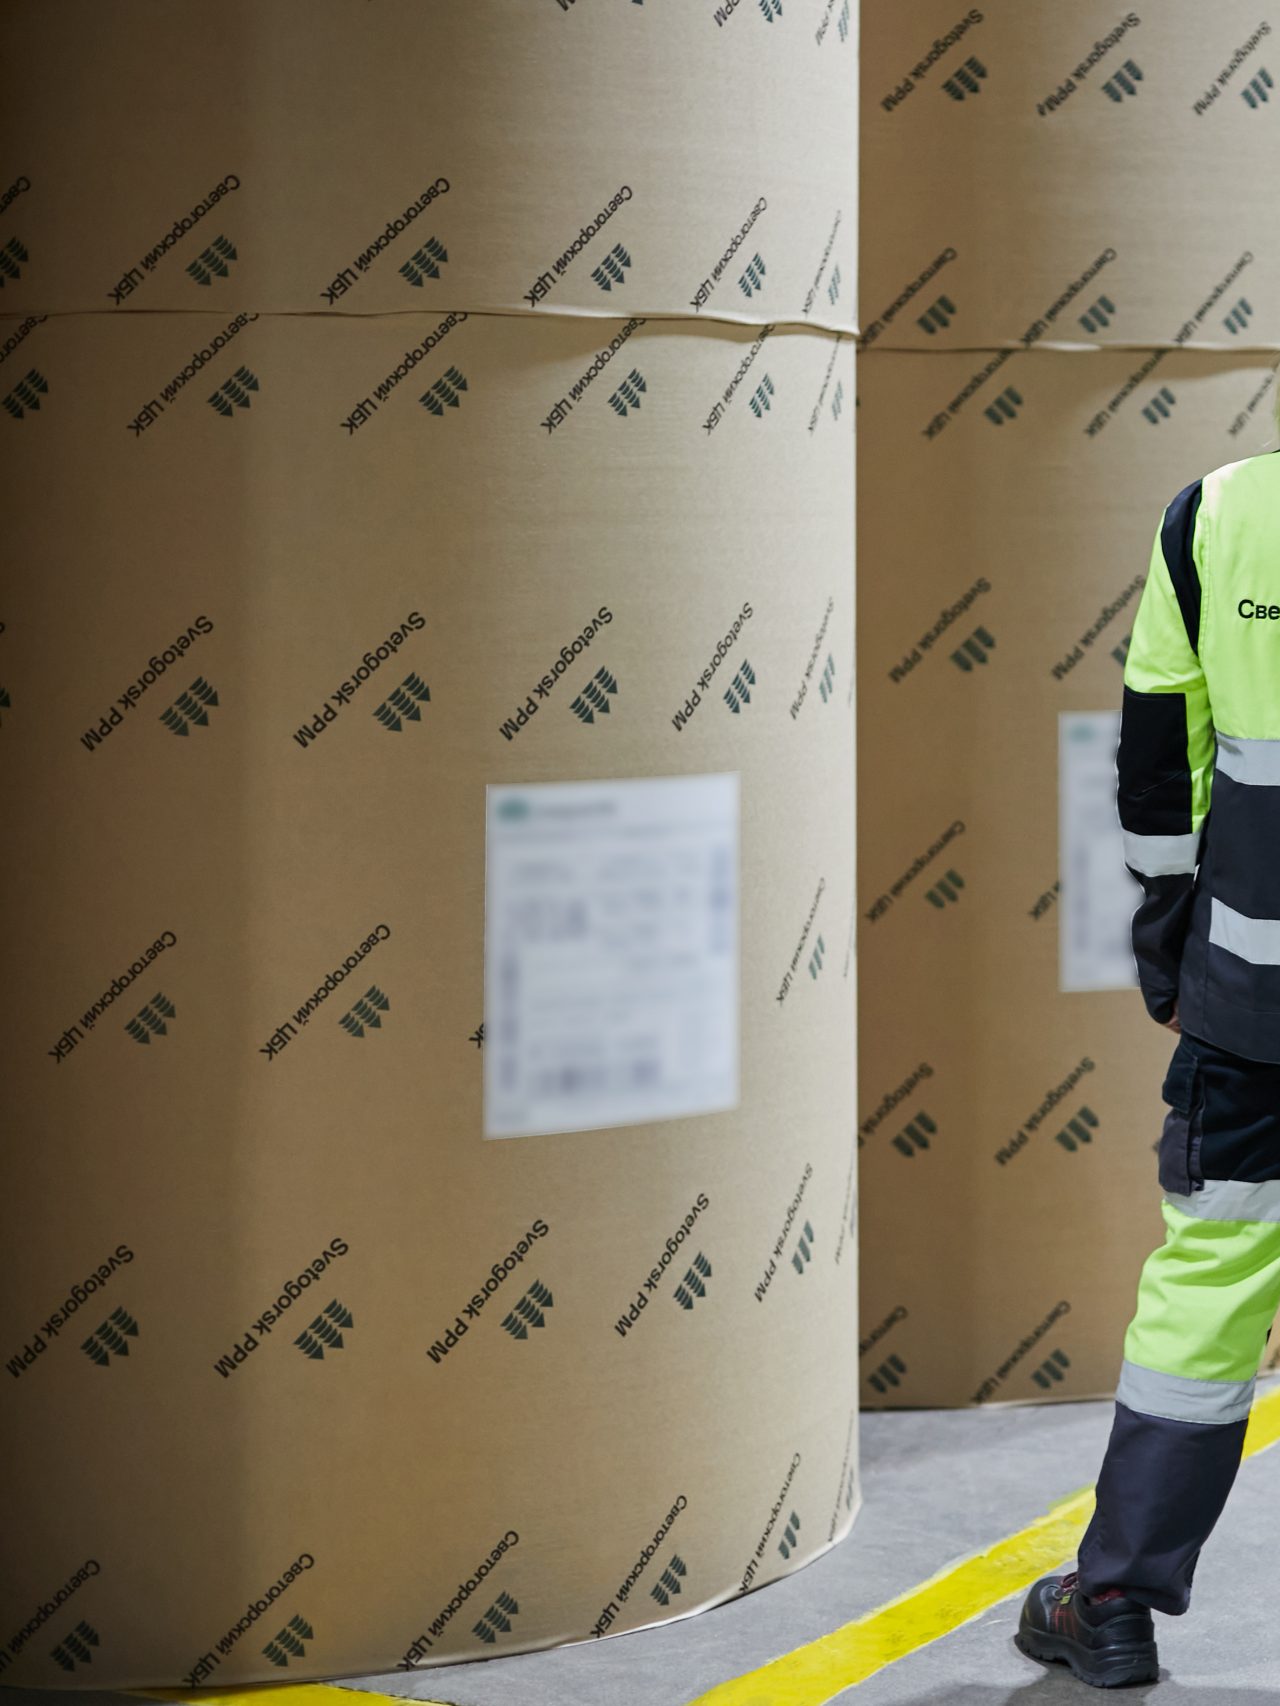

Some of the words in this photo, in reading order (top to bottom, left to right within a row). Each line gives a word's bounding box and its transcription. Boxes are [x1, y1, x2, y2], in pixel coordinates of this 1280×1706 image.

[909, 9, 983, 79] Svetogorsk
[1071, 13, 1140, 80] Svetogorsk
[1216, 22, 1271, 86] Svetogorsk
[881, 78, 915, 111] PPM
[140, 175, 240, 272] Светогорский
[354, 178, 450, 272] Светогорский
[552, 186, 632, 276] Светогорский
[711, 197, 767, 281] Светогорский
[107, 268, 144, 306] ЦБК
[320, 268, 358, 305] ЦБК
[523, 272, 556, 307] ЦБК
[690, 279, 714, 312] ЦБК
[373, 311, 468, 402] Светогорский
[569, 317, 647, 402] Светогорский
[127, 400, 164, 437] ЦБК
[340, 398, 378, 435] ЦБК
[540, 399, 572, 434] ЦБК
[702, 402, 725, 435] ЦБК
[918, 578, 991, 650] Svetogorsk
[1080, 575, 1147, 647] Svetogorsk
[117, 616, 213, 710] Svetogorsk
[331, 612, 425, 706] Svetogorsk
[533, 607, 612, 699] Svetogorsk
[697, 602, 752, 691] Svetogorsk
[888, 649, 922, 683] PPM
[1052, 646, 1084, 680] PPM
[80, 707, 123, 751] PPM
[293, 703, 338, 748] PPM
[499, 697, 538, 741] PPM
[672, 690, 701, 731] PPM
[80, 931, 176, 1030] Светогорский
[293, 925, 390, 1026] Светогорский
[48, 1026, 84, 1064] ЦБК
[259, 1023, 297, 1061] ЦБК
[858, 1063, 933, 1135] Svetogorsk
[1024, 1058, 1094, 1131] Svetogorsk
[995, 1131, 1028, 1166] PPM
[643, 1193, 709, 1292] Svetogorsk
[773, 1163, 812, 1258] Svetogorsk
[41, 1245, 134, 1338] Svetogorsk
[252, 1238, 348, 1335] Svetogorsk
[462, 1220, 549, 1319] Svetogorsk
[755, 1259, 776, 1302] PPM
[427, 1318, 469, 1363] PPM
[615, 1292, 648, 1337] PPM
[6, 1334, 47, 1378] PPM
[214, 1333, 259, 1378] PPM
[755, 1453, 800, 1558] Светогорский
[616, 1495, 687, 1602] Светогорский
[7, 1560, 100, 1654] Светогорский
[216, 1554, 314, 1655] Светогорский
[428, 1531, 519, 1637] Светогорский
[397, 1635, 433, 1672] ЦБК
[590, 1602, 620, 1638] ЦБК
[182, 1652, 220, 1693] ЦБК
